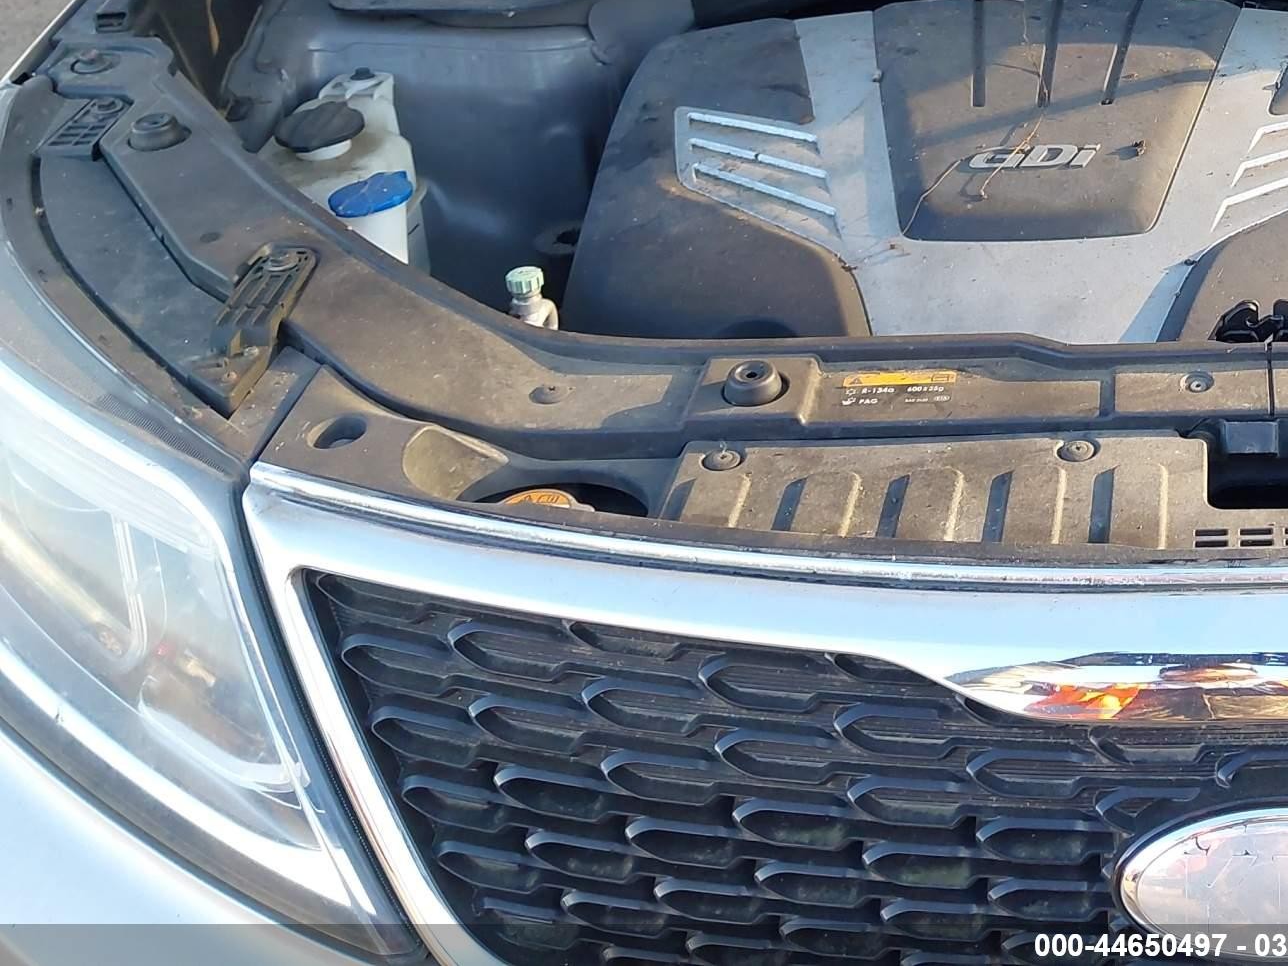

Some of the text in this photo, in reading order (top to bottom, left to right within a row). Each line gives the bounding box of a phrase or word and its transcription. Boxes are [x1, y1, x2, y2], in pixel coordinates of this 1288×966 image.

[968, 143, 1101, 170] GDi
[861, 386, 896, 395] R-134a
[858, 397, 879, 405] PAG
